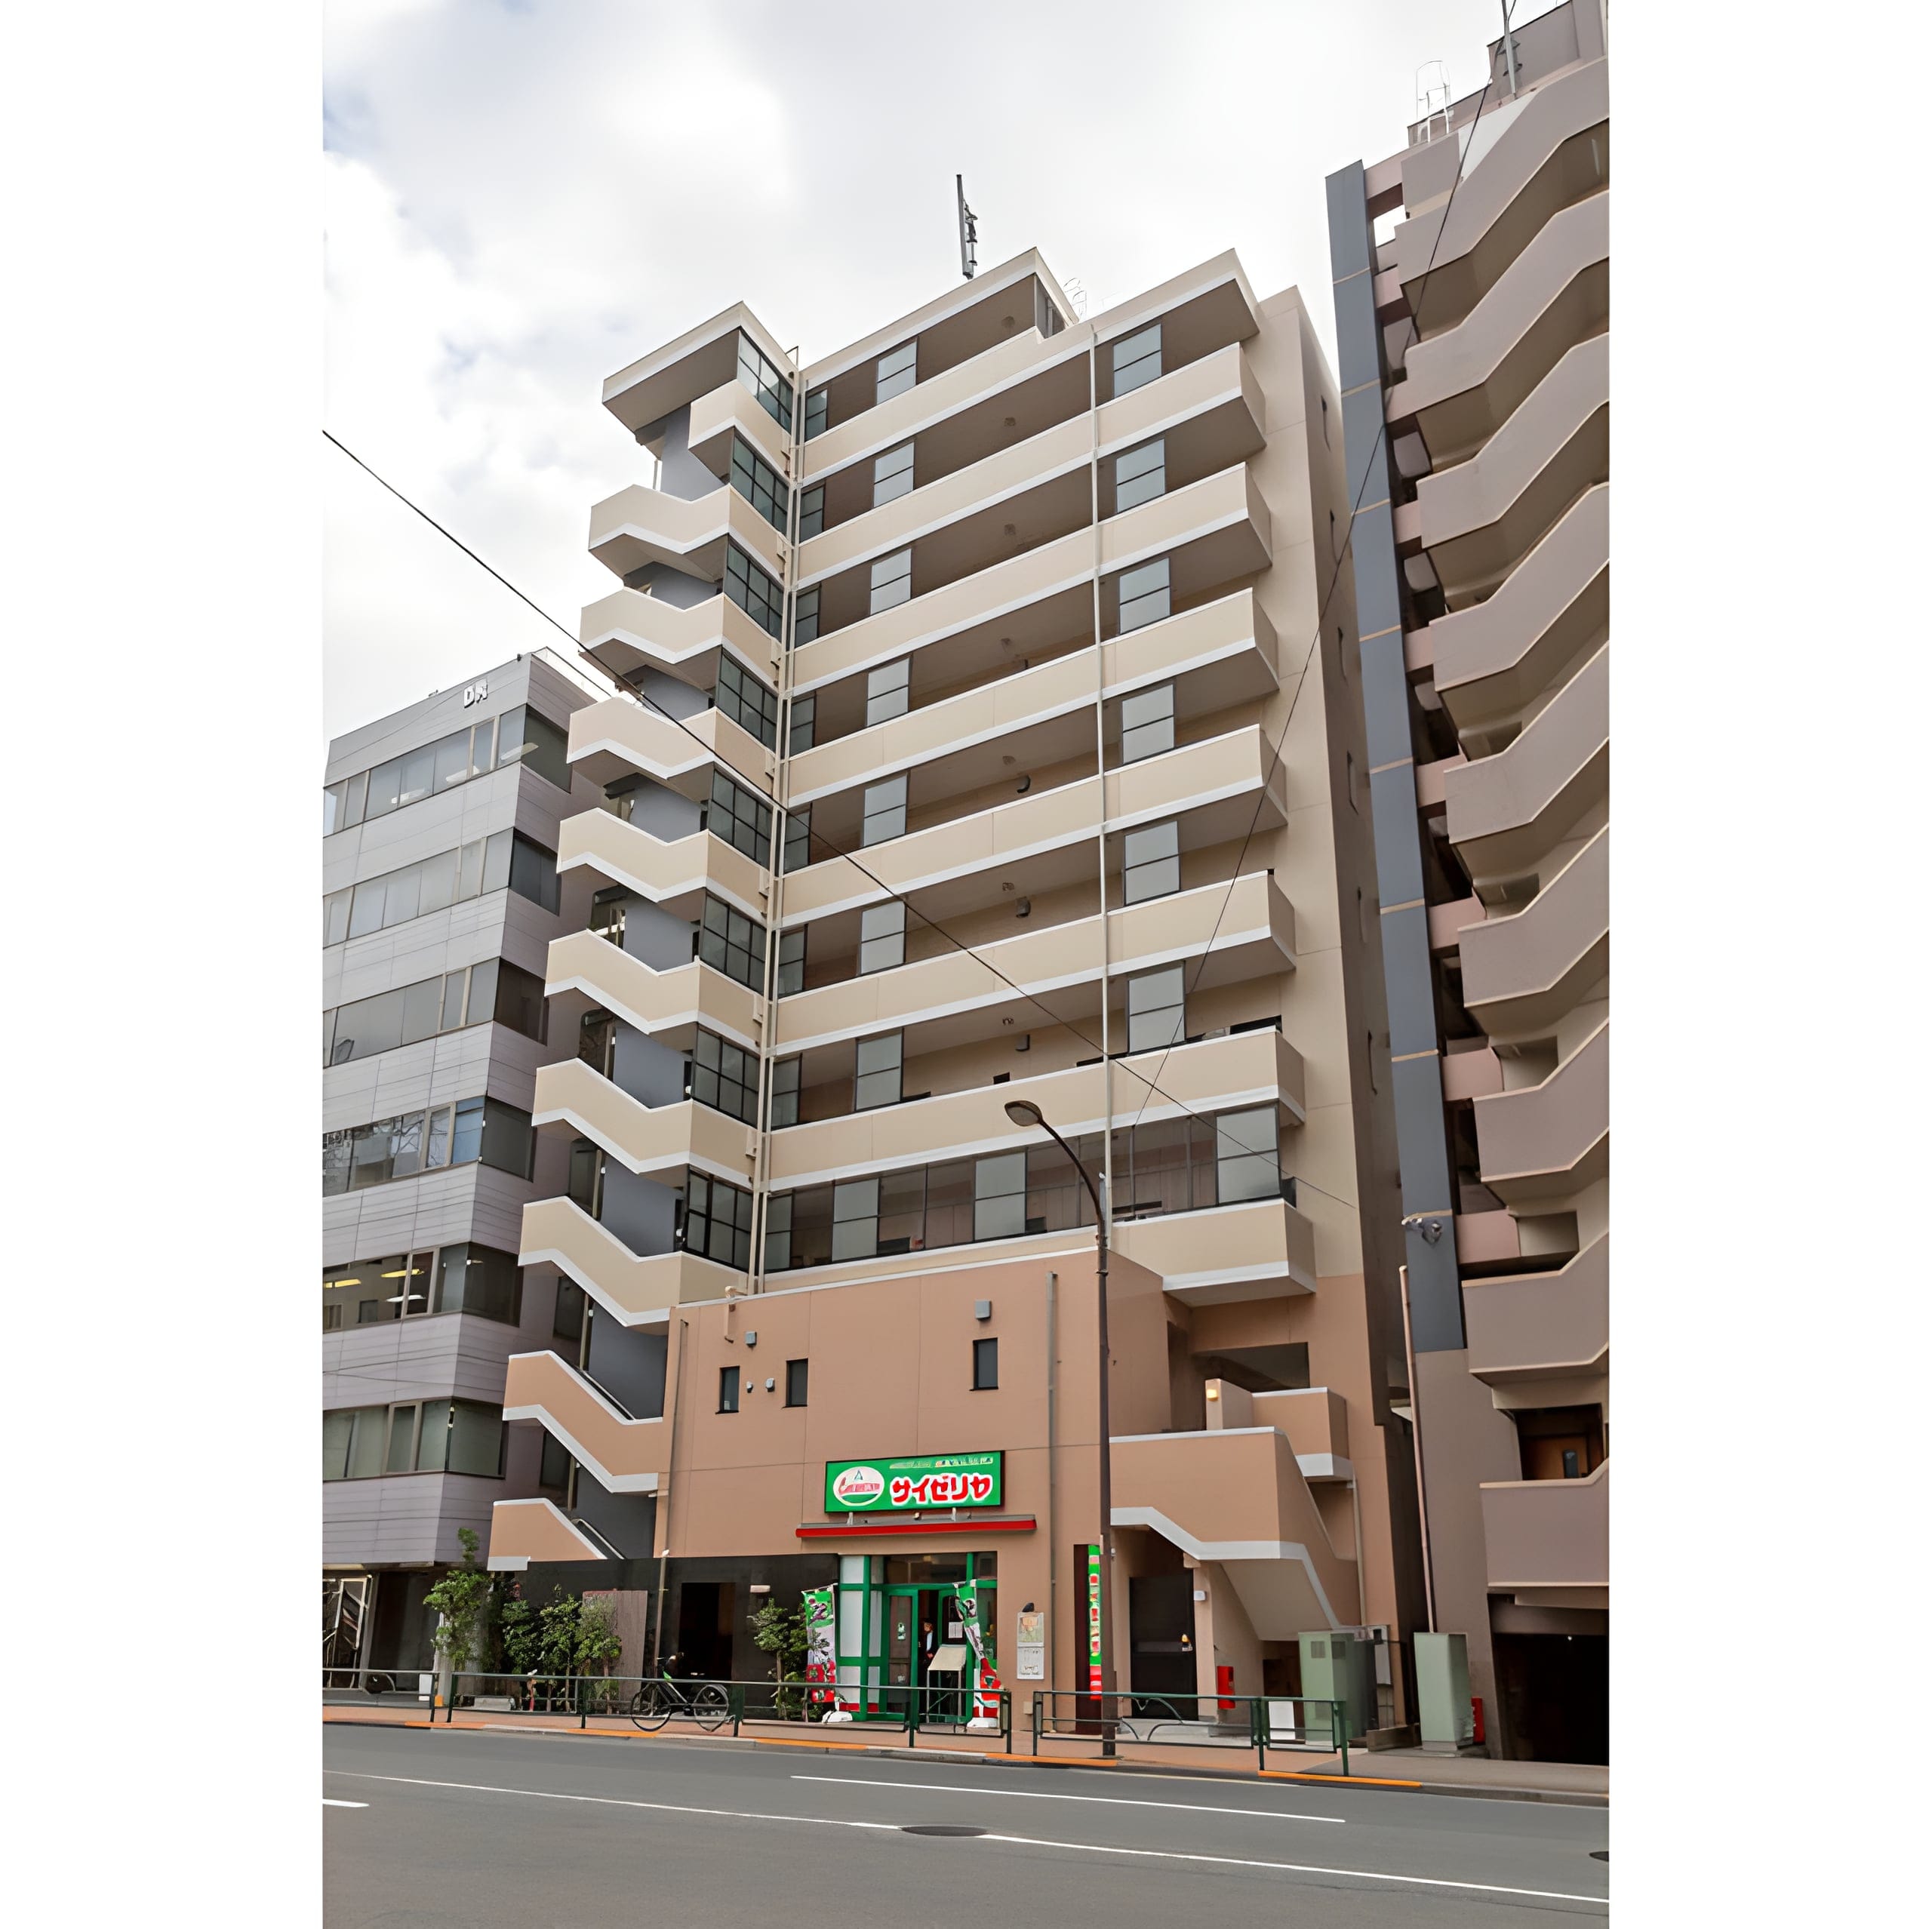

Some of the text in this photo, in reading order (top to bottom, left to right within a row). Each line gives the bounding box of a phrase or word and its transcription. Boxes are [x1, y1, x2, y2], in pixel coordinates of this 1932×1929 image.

[891, 1474, 992, 1504] サイゼリヤ
